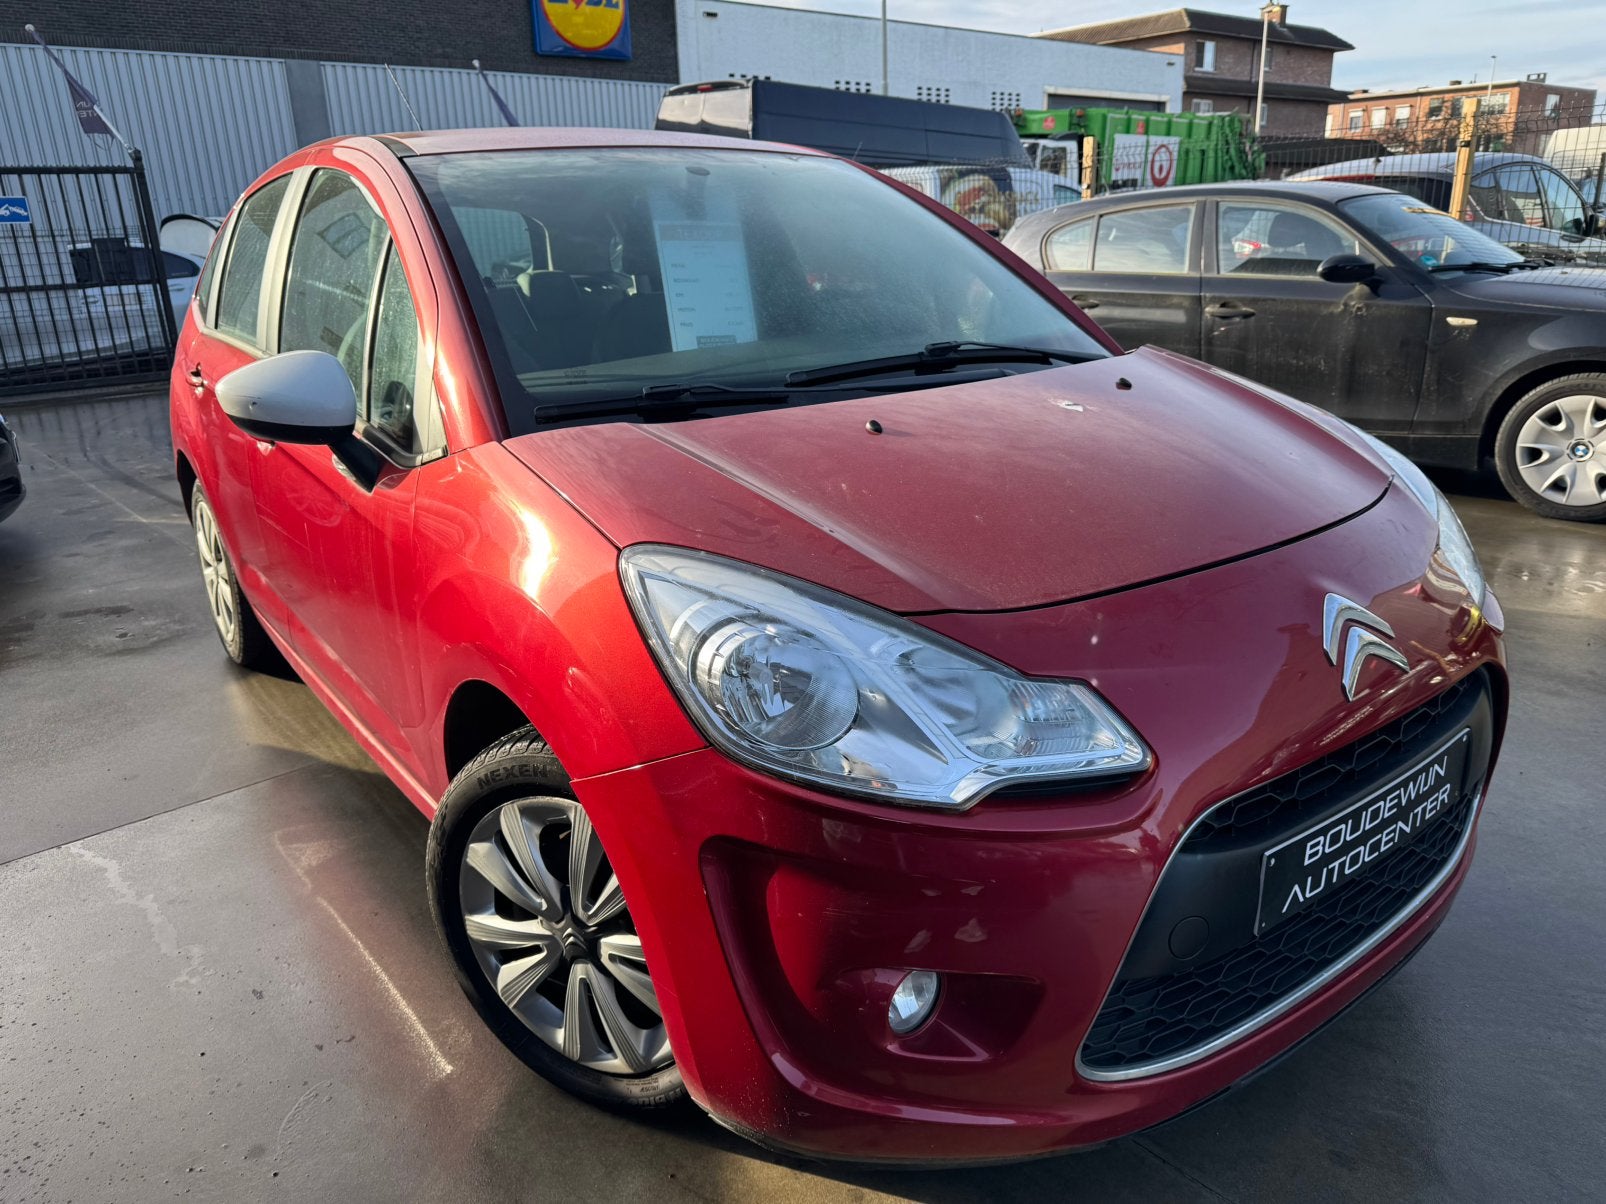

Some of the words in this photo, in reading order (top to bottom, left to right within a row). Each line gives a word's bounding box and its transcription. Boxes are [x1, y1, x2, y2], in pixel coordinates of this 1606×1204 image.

[477, 764, 549, 789] NEXEN
[1304, 755, 1448, 867] BOUDEWIJN
[1282, 784, 1450, 913] AUTOCENTER
